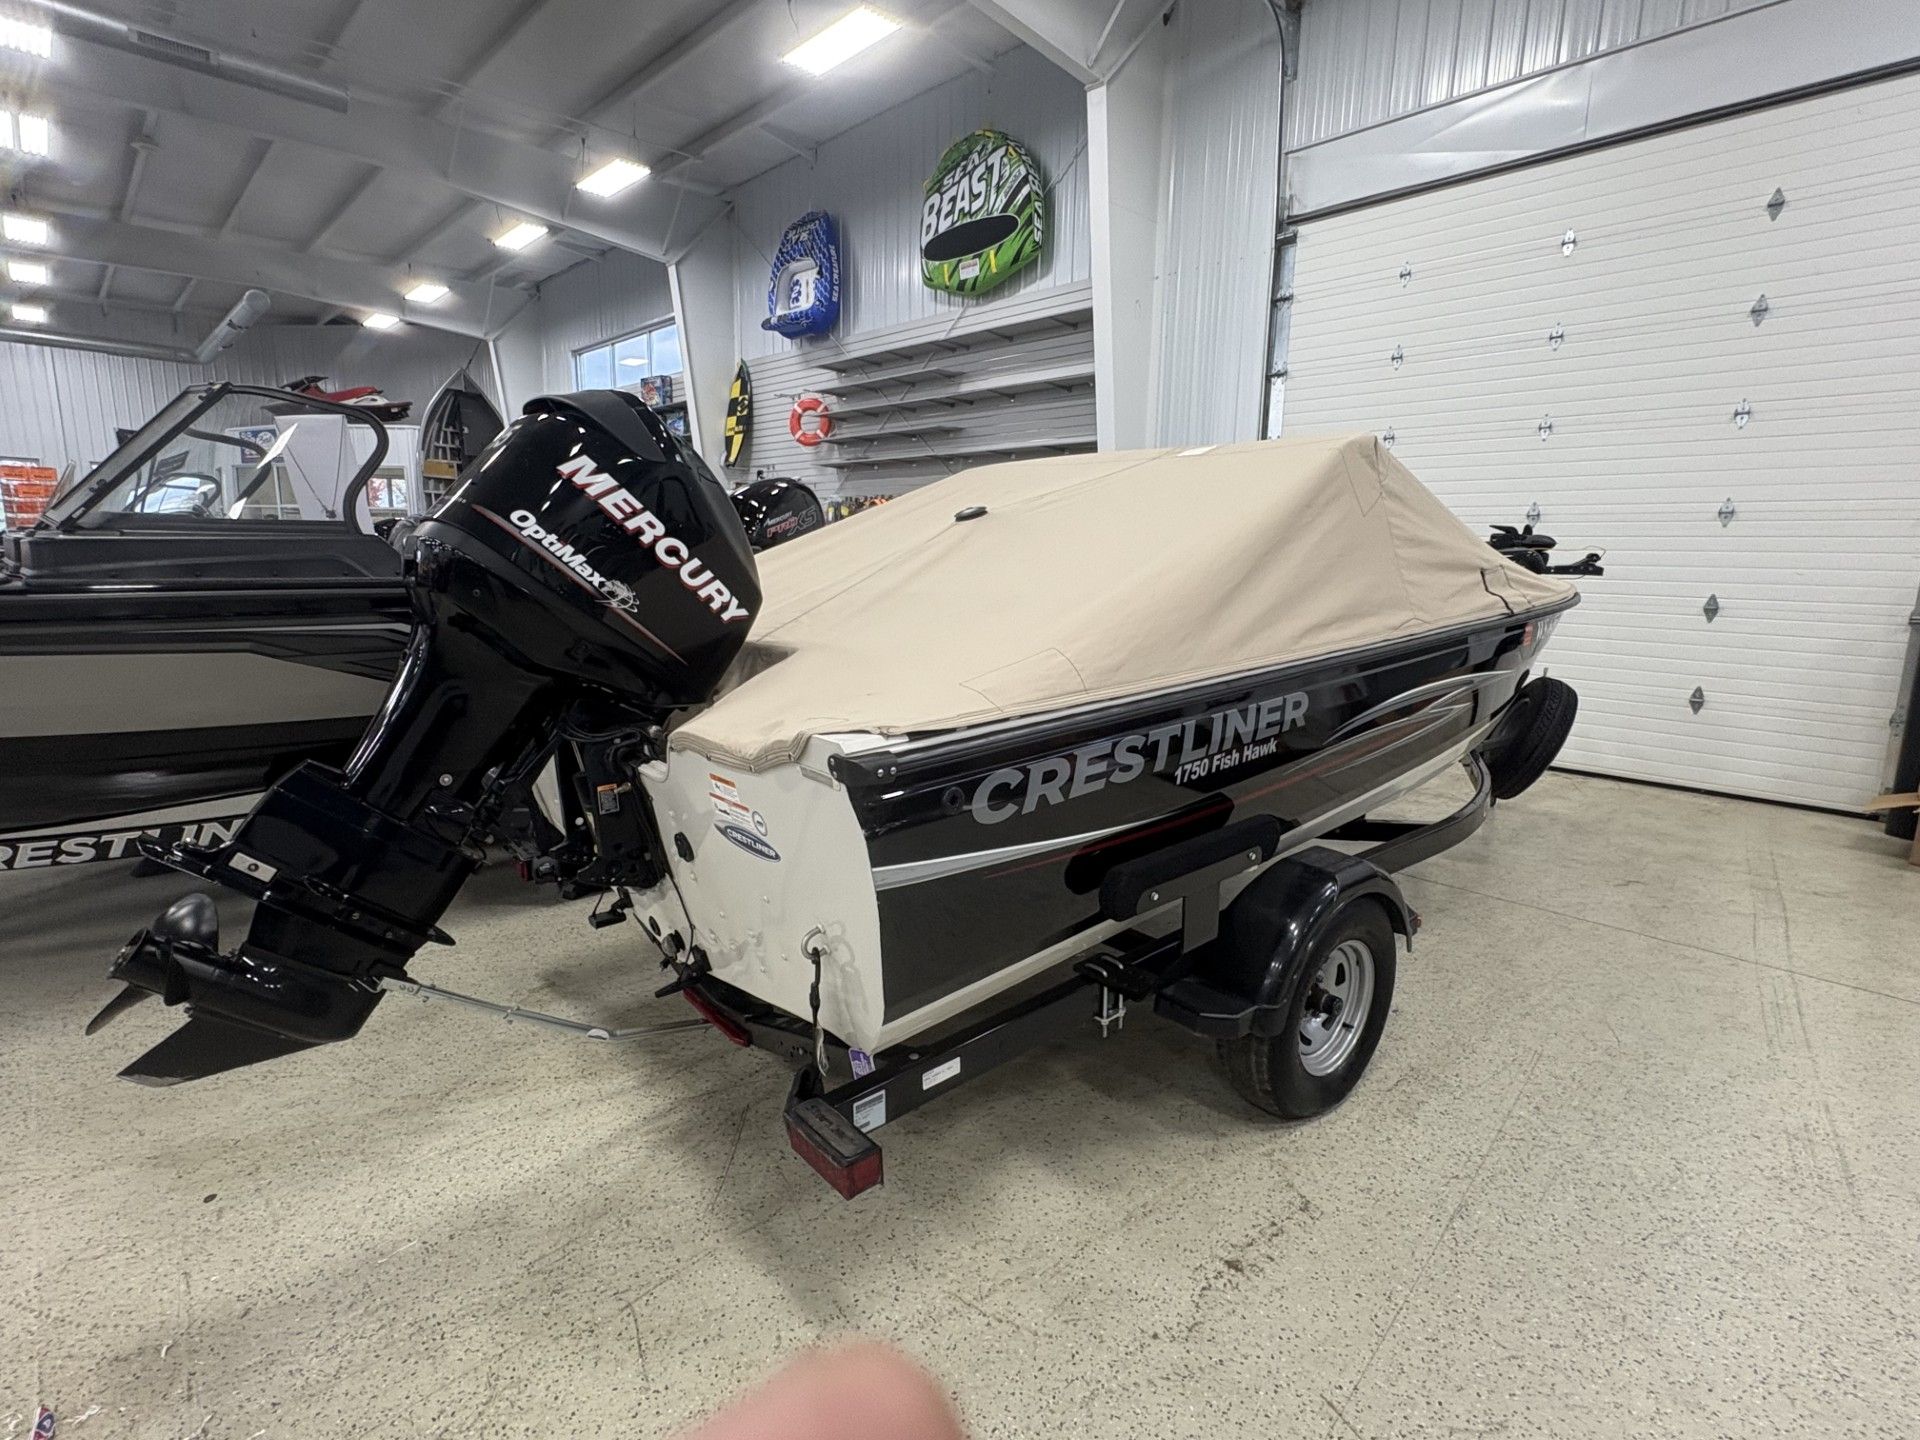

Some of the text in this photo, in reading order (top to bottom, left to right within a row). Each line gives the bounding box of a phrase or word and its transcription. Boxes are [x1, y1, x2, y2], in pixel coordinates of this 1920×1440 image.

[921, 145, 1008, 249] BEAST
[943, 152, 980, 192] SEA
[1033, 201, 1043, 242] SEA
[509, 509, 607, 588] OptiMax
[556, 454, 749, 624] MERCURY
[971, 691, 1309, 825] CRESTLINER
[1174, 737, 1278, 786] 1750 Fish Hawk
[726, 828, 777, 858] CRESTLINER
